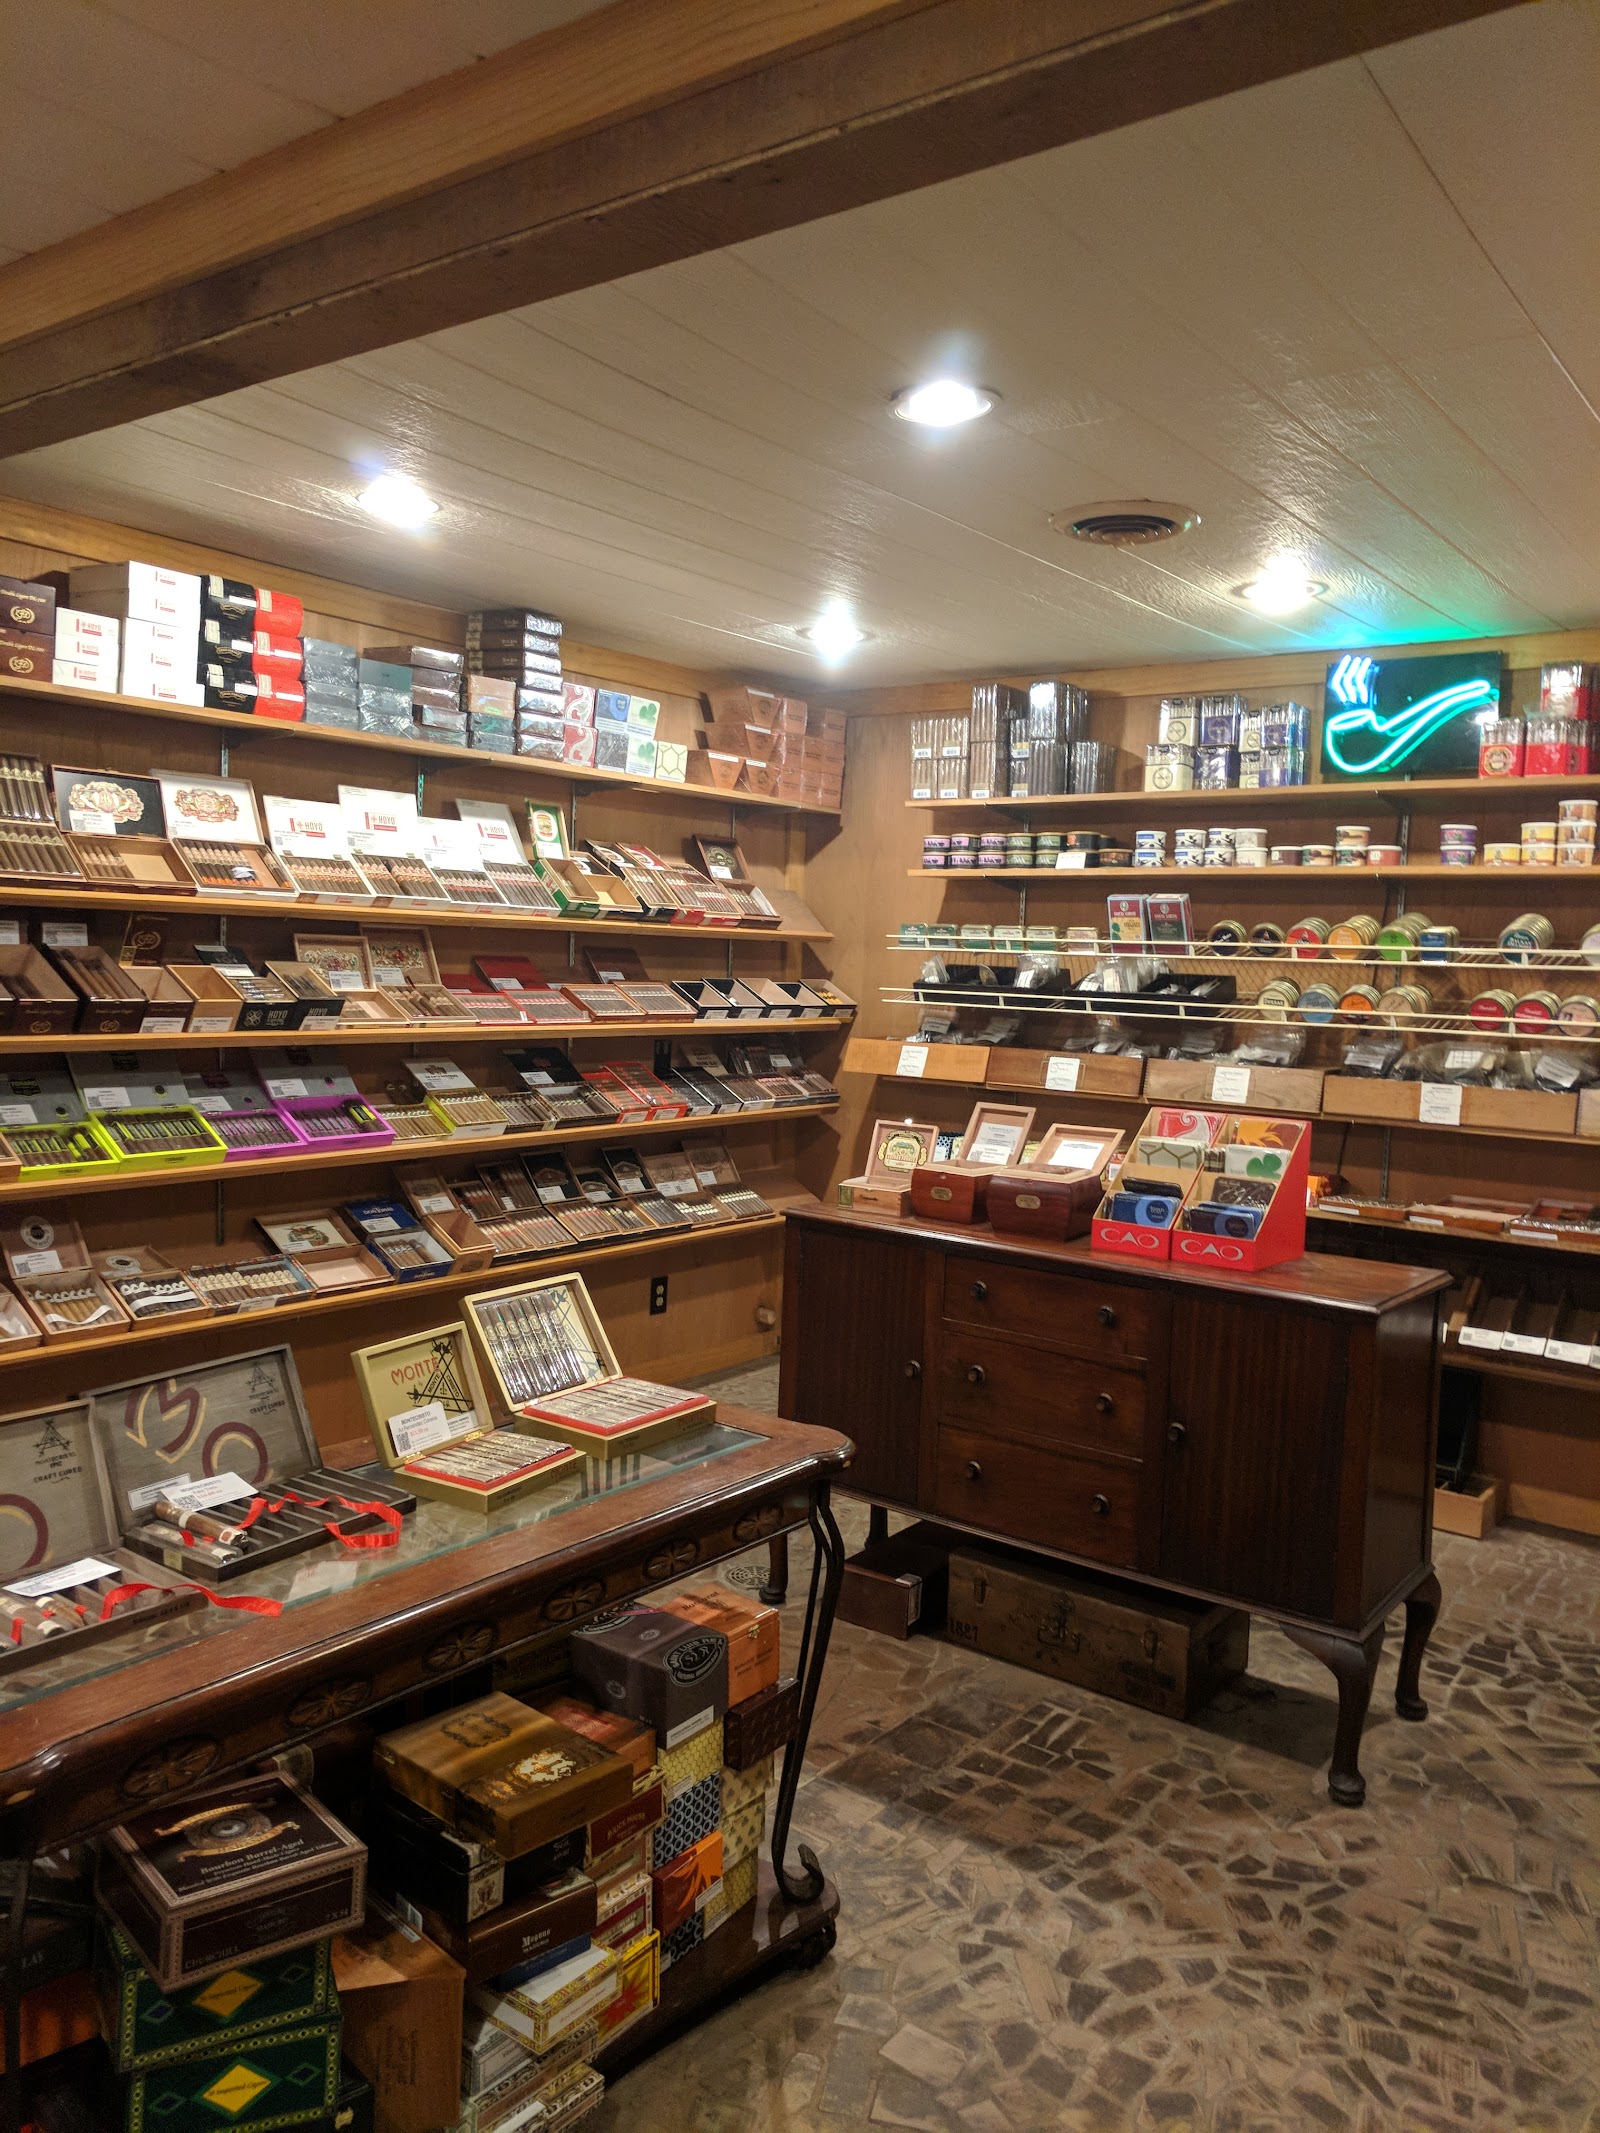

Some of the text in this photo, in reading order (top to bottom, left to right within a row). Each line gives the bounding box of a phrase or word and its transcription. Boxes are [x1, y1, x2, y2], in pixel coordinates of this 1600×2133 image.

[304, 821, 323, 831] HOYO
[379, 815, 396, 825] HOYO
[490, 826, 505, 834] HOYO
[268, 1010, 288, 1019] HOYO
[308, 1008, 328, 1016] HOYO
[1100, 1227, 1159, 1249] CAO
[1180, 1239, 1243, 1261] CAO
[564, 1324, 582, 1348] CRISTO
[390, 1356, 439, 1385] MONTE
[427, 1373, 440, 1394] MONTE
[446, 1374, 460, 1398] CRISTO
[401, 1411, 431, 1425] MONTECRISTO
[34, 1466, 82, 1483] CRAFT CURED
[200, 1838, 305, 1875] Bourbon Barrel-Aged
